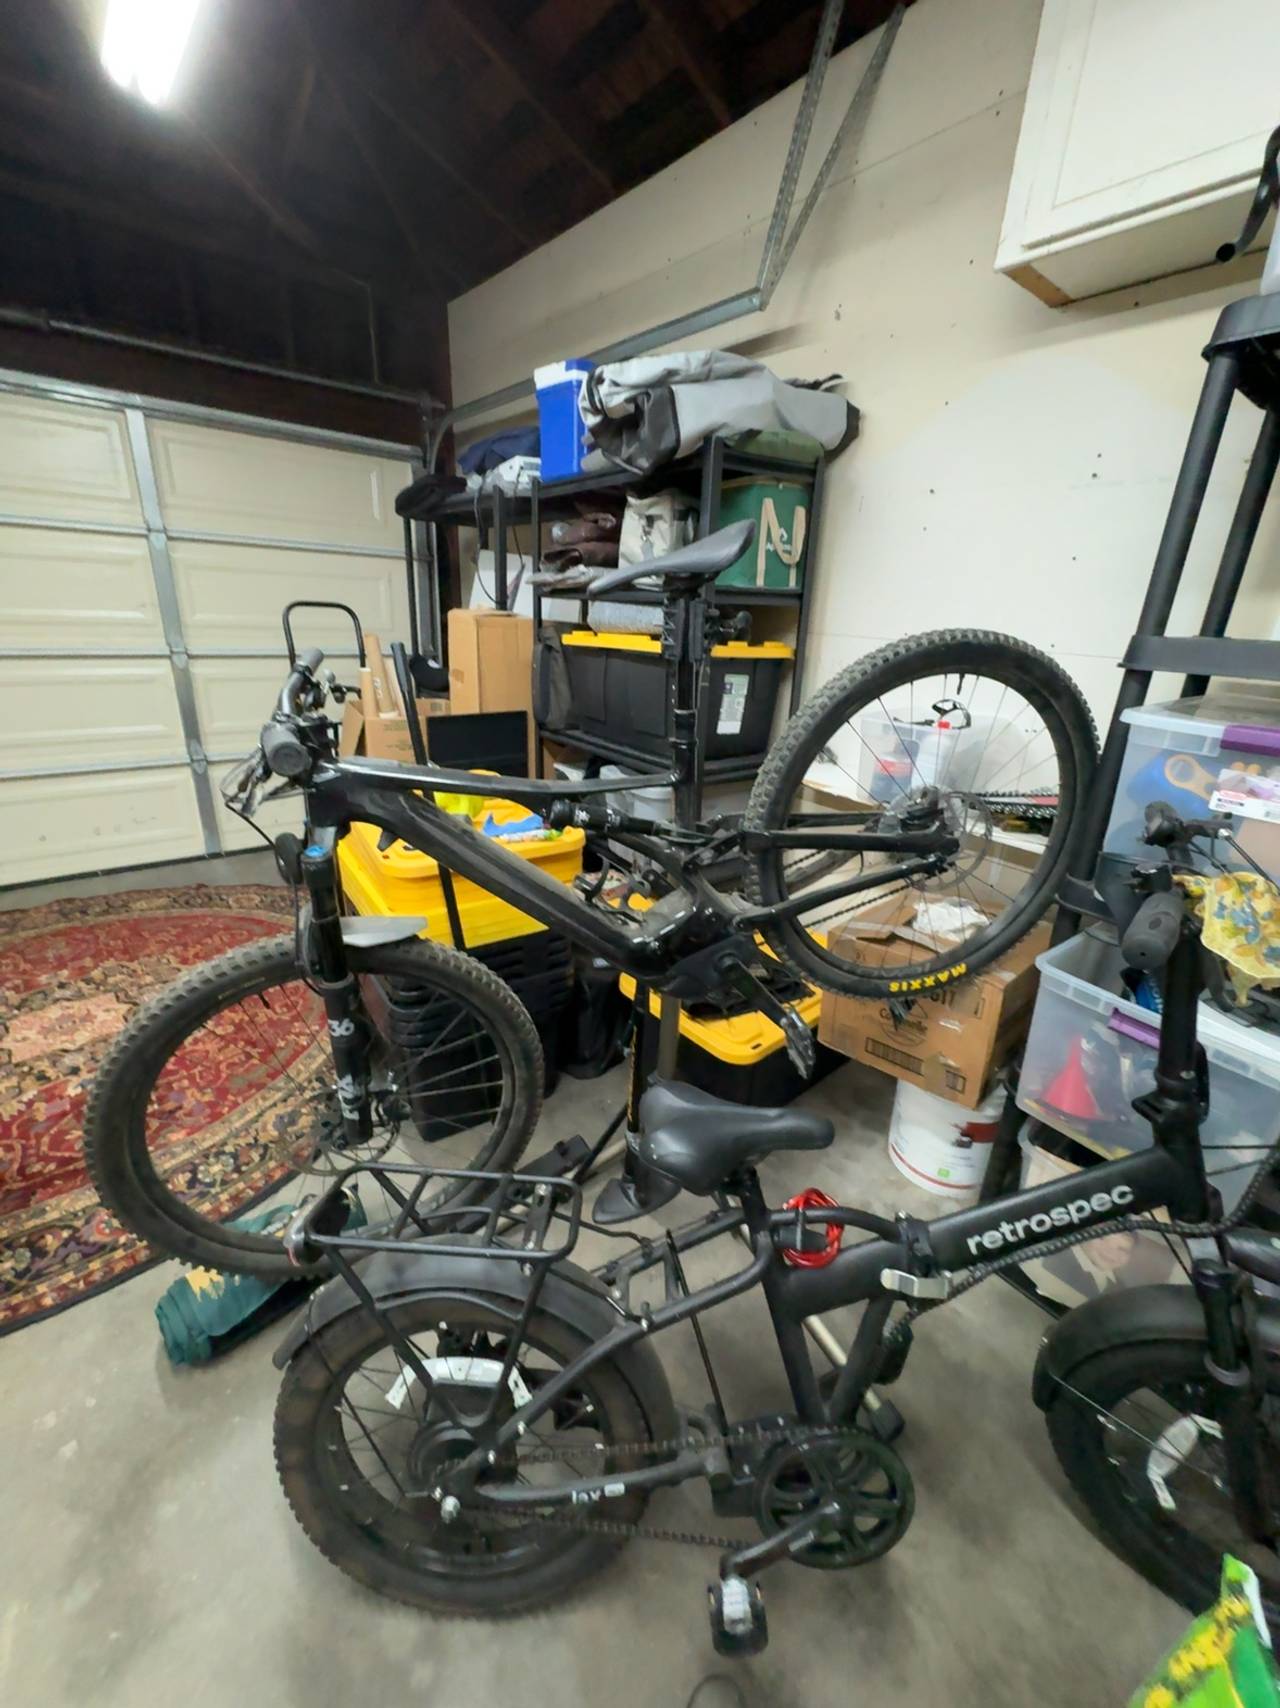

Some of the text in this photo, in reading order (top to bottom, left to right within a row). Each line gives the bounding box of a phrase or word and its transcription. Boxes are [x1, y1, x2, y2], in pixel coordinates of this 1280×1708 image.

[888, 962, 967, 992] MAXXIS
[327, 1018, 355, 1037] 36
[966, 1184, 1134, 1256] retrospec
